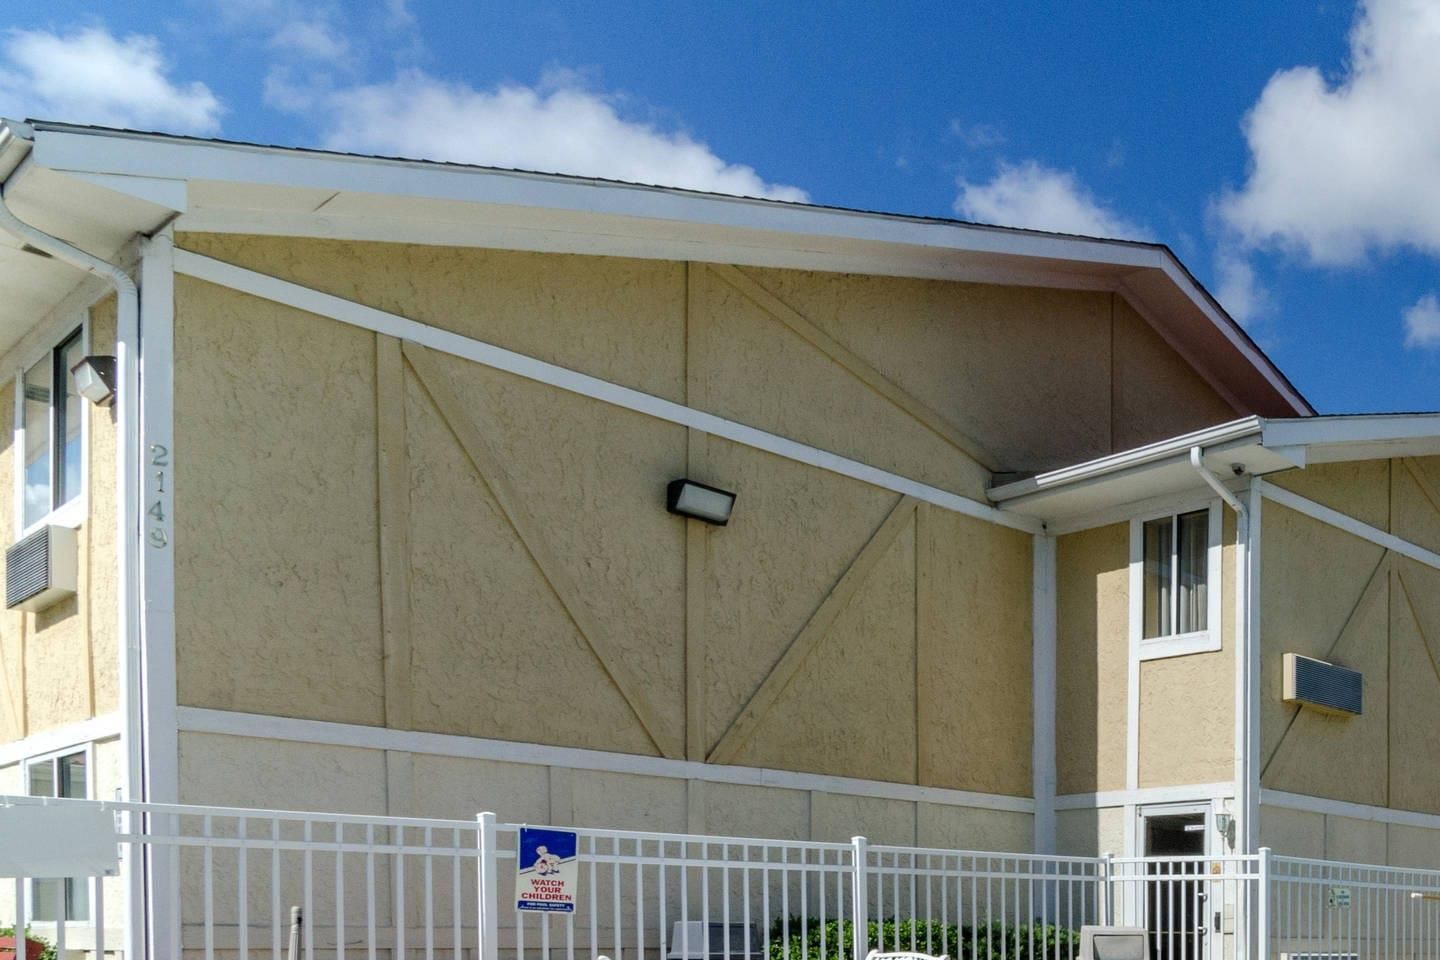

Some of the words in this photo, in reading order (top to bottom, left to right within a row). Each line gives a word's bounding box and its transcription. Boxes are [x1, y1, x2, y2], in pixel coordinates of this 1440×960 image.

[148, 444, 169, 550] 2149
[530, 878, 565, 887] WATCH
[521, 892, 572, 901] CHILDREN
